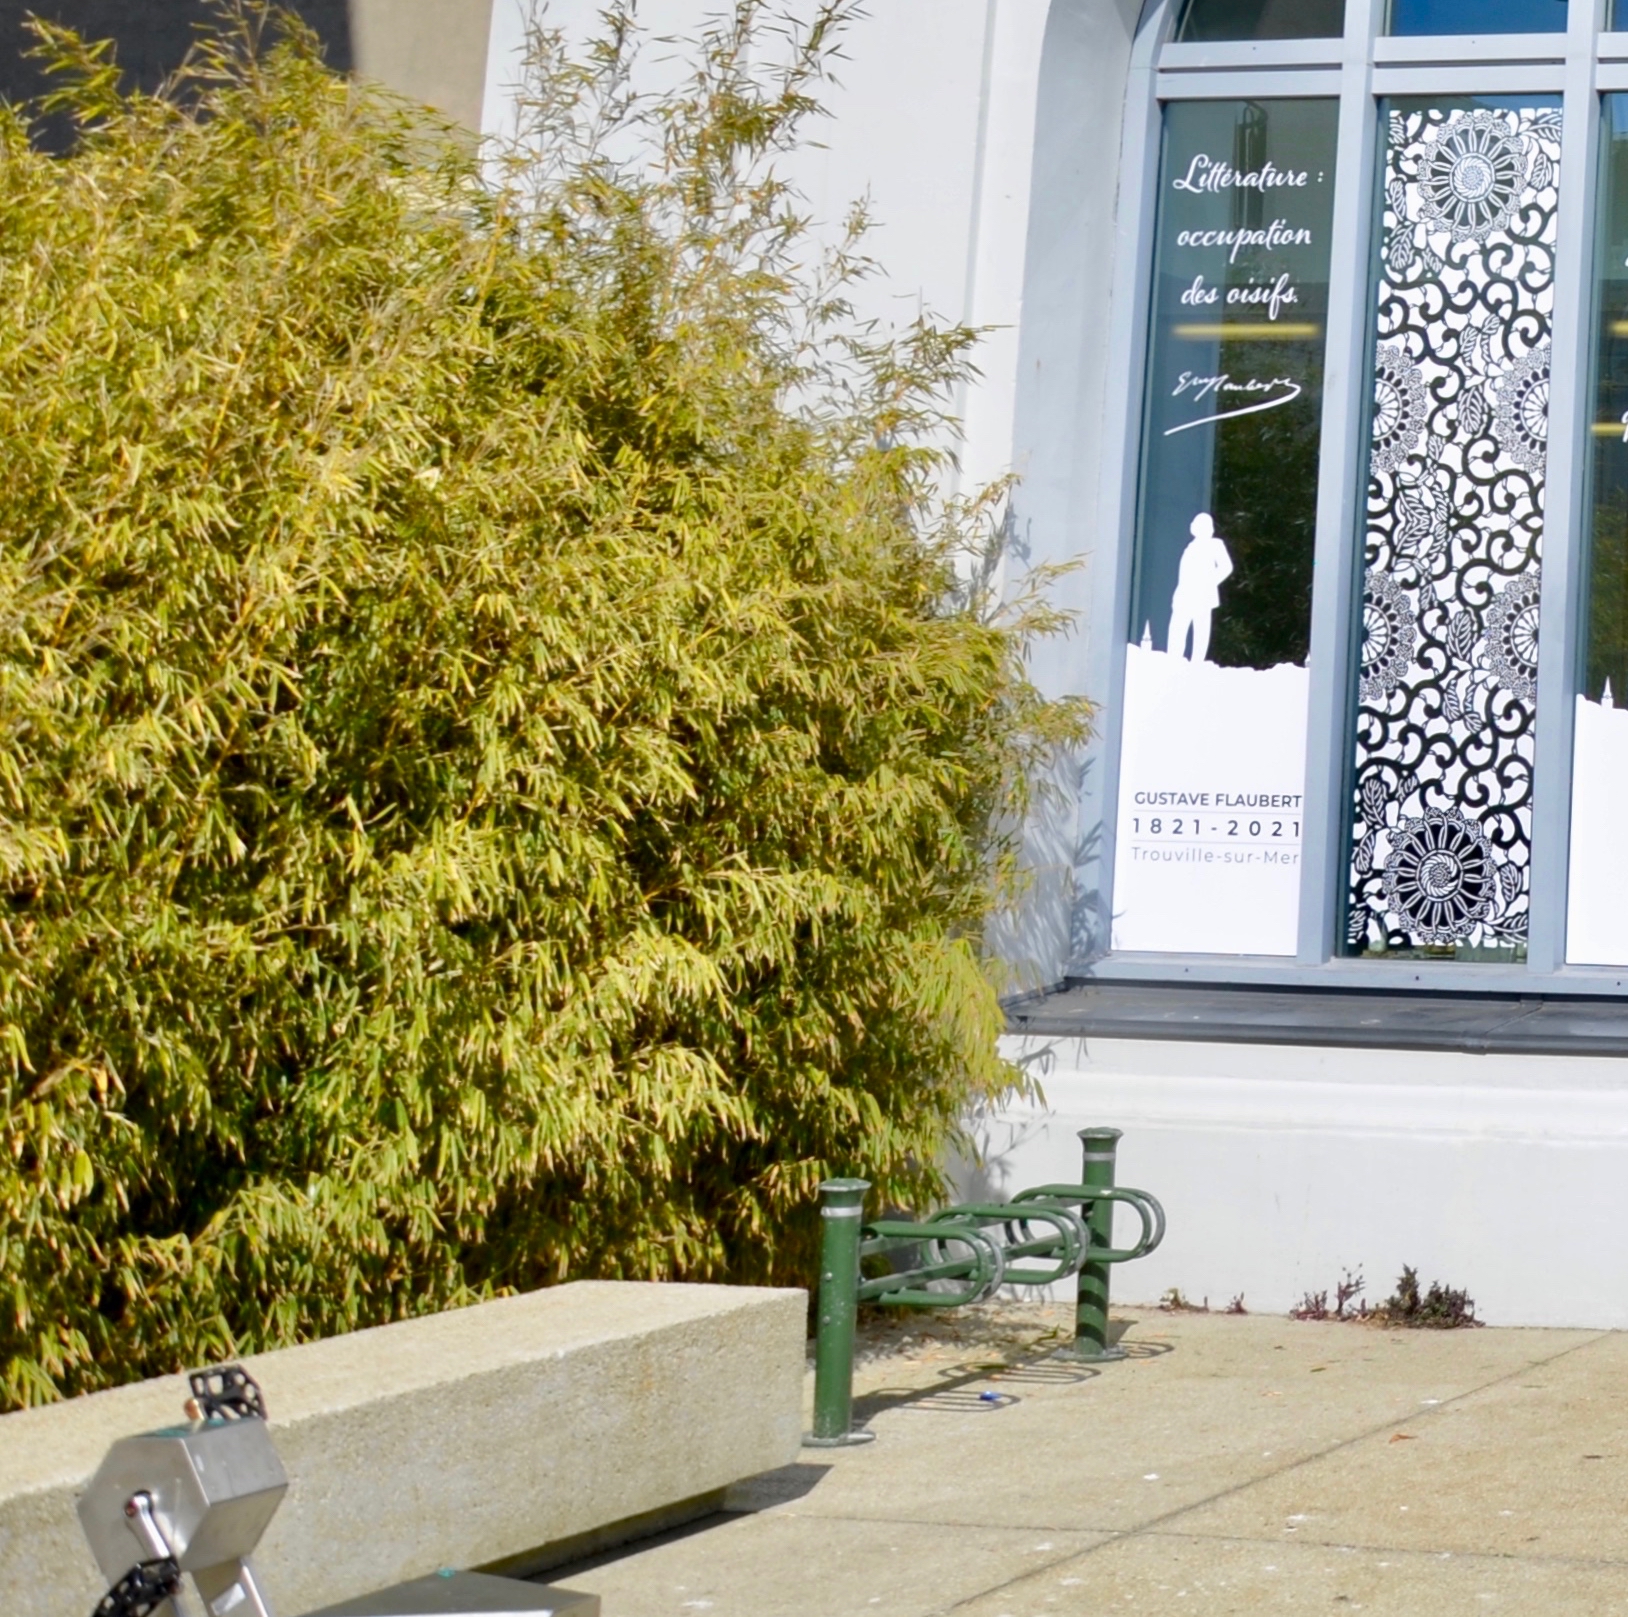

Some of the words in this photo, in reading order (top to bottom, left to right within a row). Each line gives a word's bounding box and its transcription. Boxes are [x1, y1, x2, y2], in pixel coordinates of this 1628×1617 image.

[1173, 154, 1308, 194] Littérature
[1177, 219, 1312, 264] occupation
[1181, 275, 1218, 305] des
[1226, 272, 1298, 320] oisifs.
[1134, 792, 1209, 806] GUSTAVE
[1215, 793, 1302, 808] FLAUBERT
[1131, 847, 1300, 864] Trouville-sur-Mer
